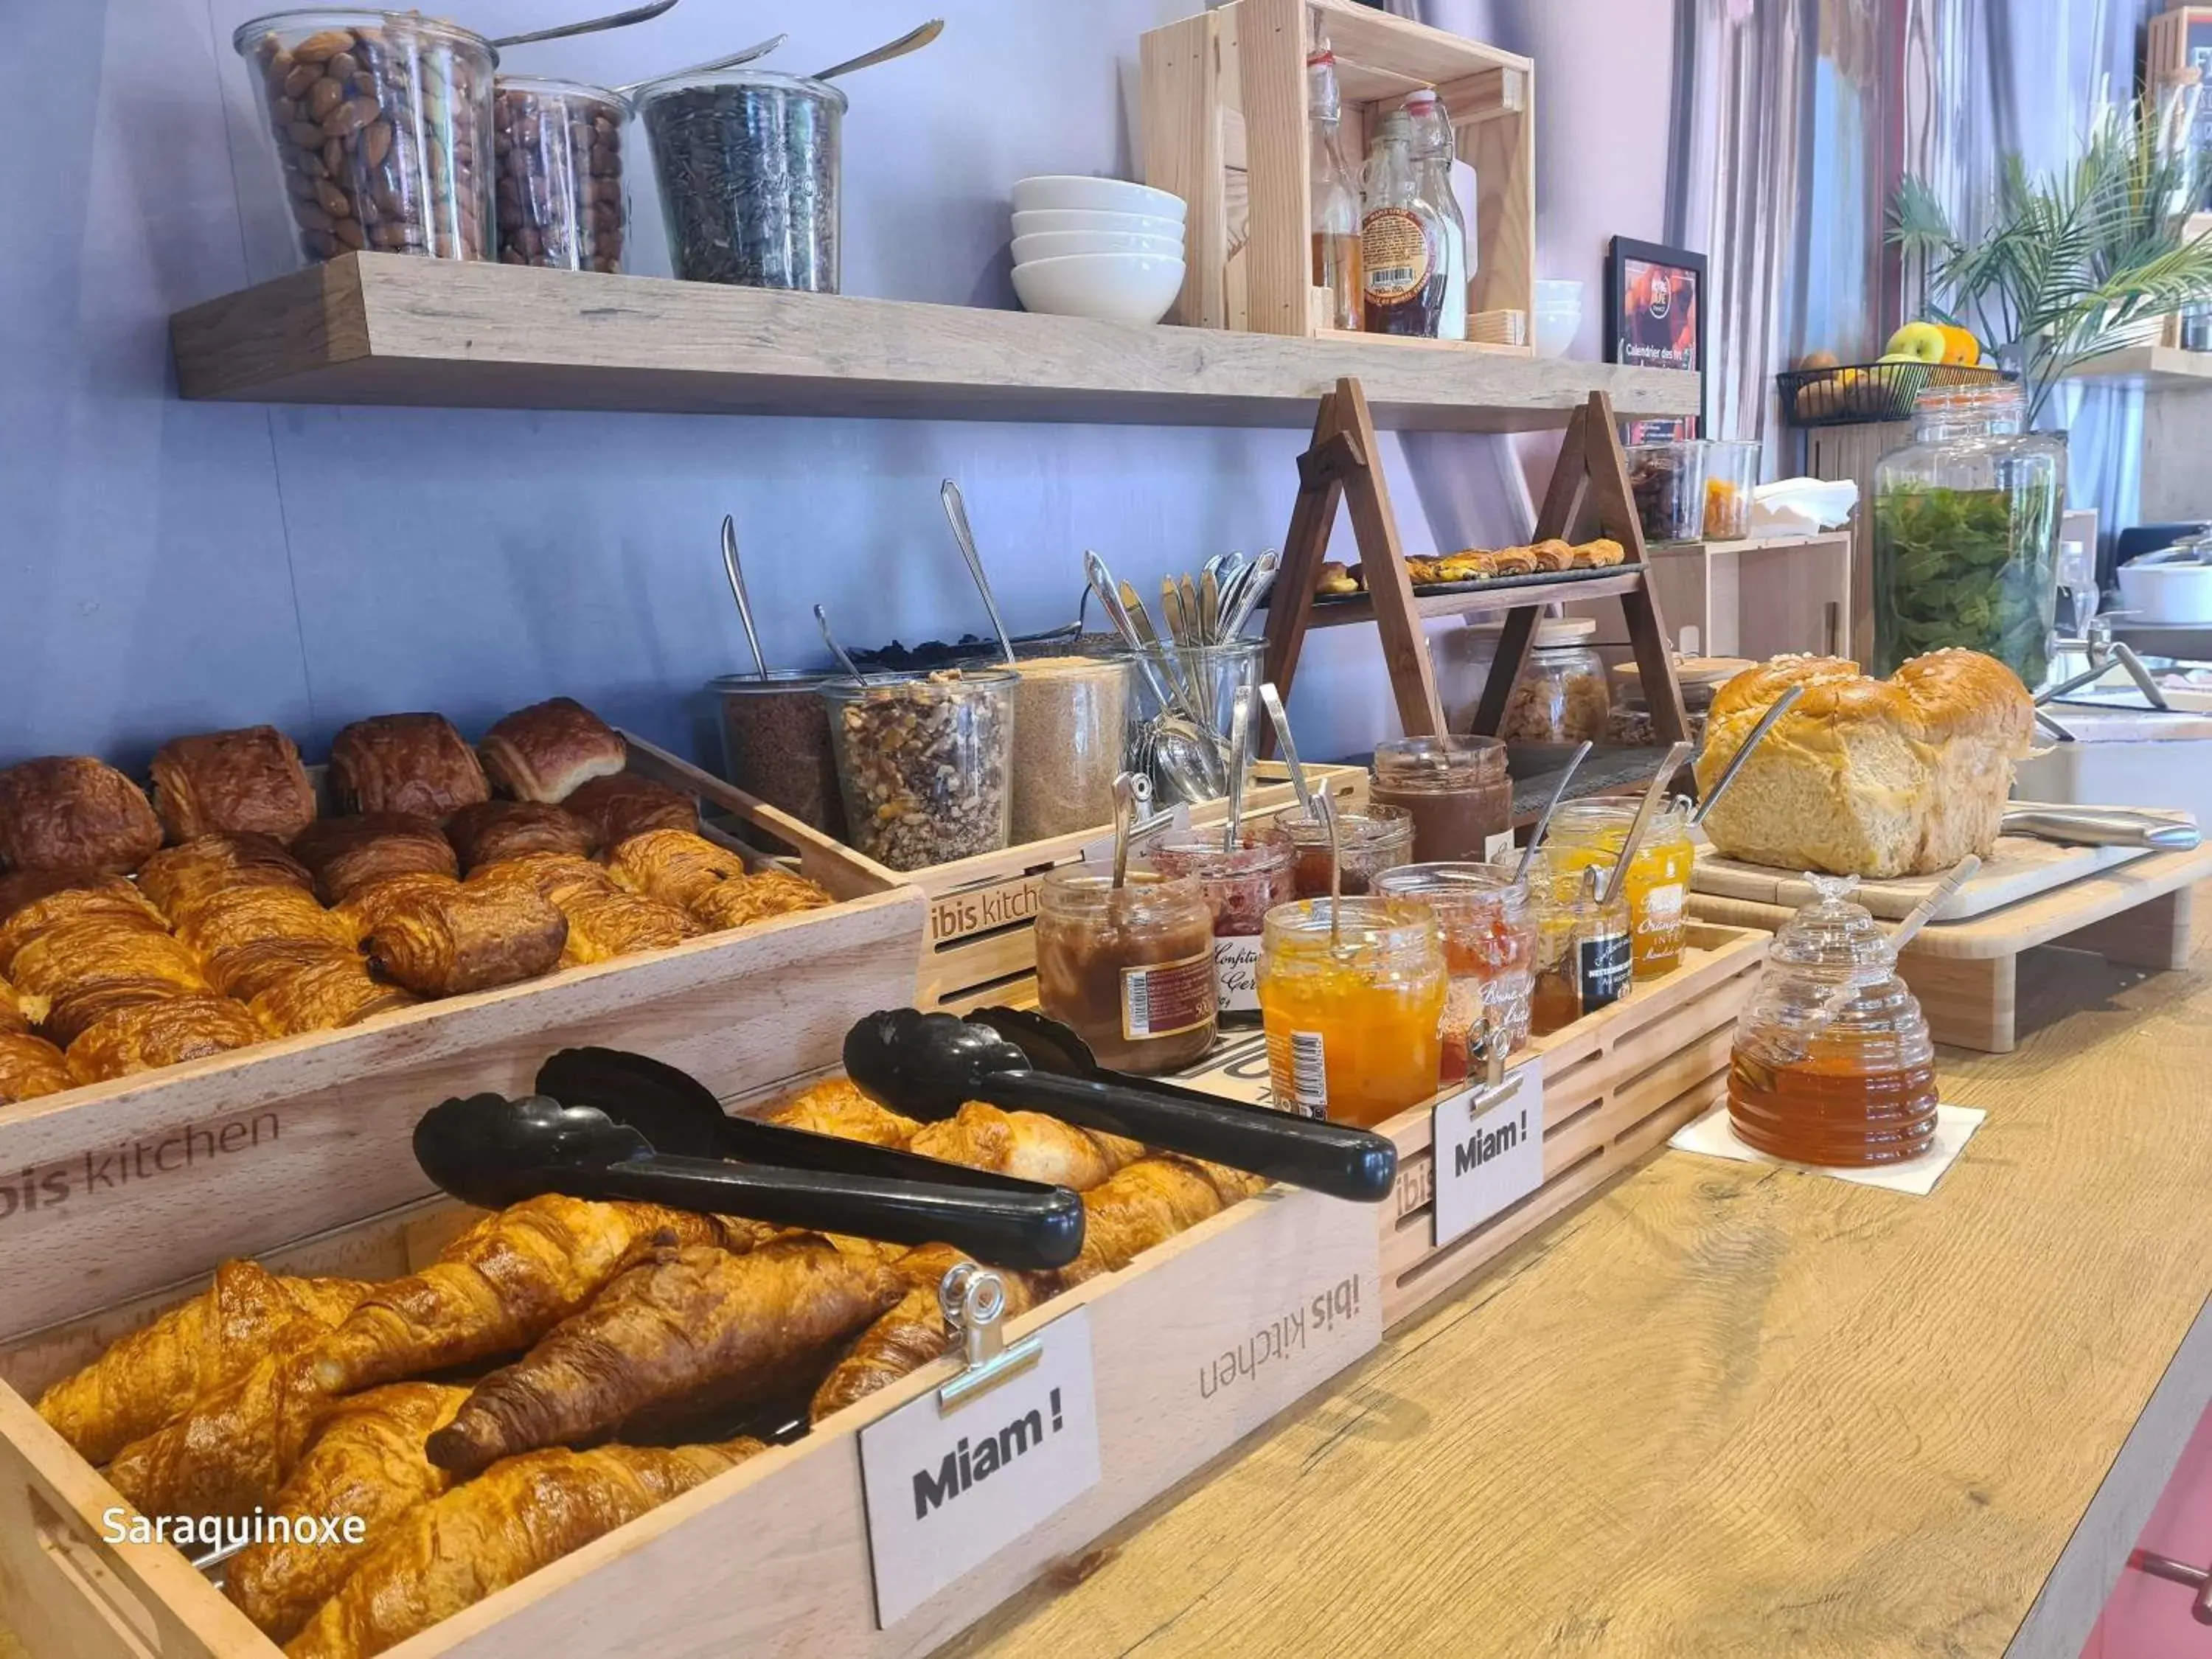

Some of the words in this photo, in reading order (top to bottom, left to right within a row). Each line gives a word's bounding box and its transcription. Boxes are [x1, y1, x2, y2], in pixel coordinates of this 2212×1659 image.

[931, 900, 978, 939] ibis
[981, 883, 1040, 925] kitch
[85, 1113, 279, 1194] kitchen
[1455, 1121, 1517, 1178] Miam
[1520, 1109, 1527, 1142] !
[1311, 1273, 1360, 1332] ibis
[1200, 1307, 1305, 1399] kitchen
[912, 1408, 1043, 1521] Miam
[1049, 1387, 1062, 1433] !
